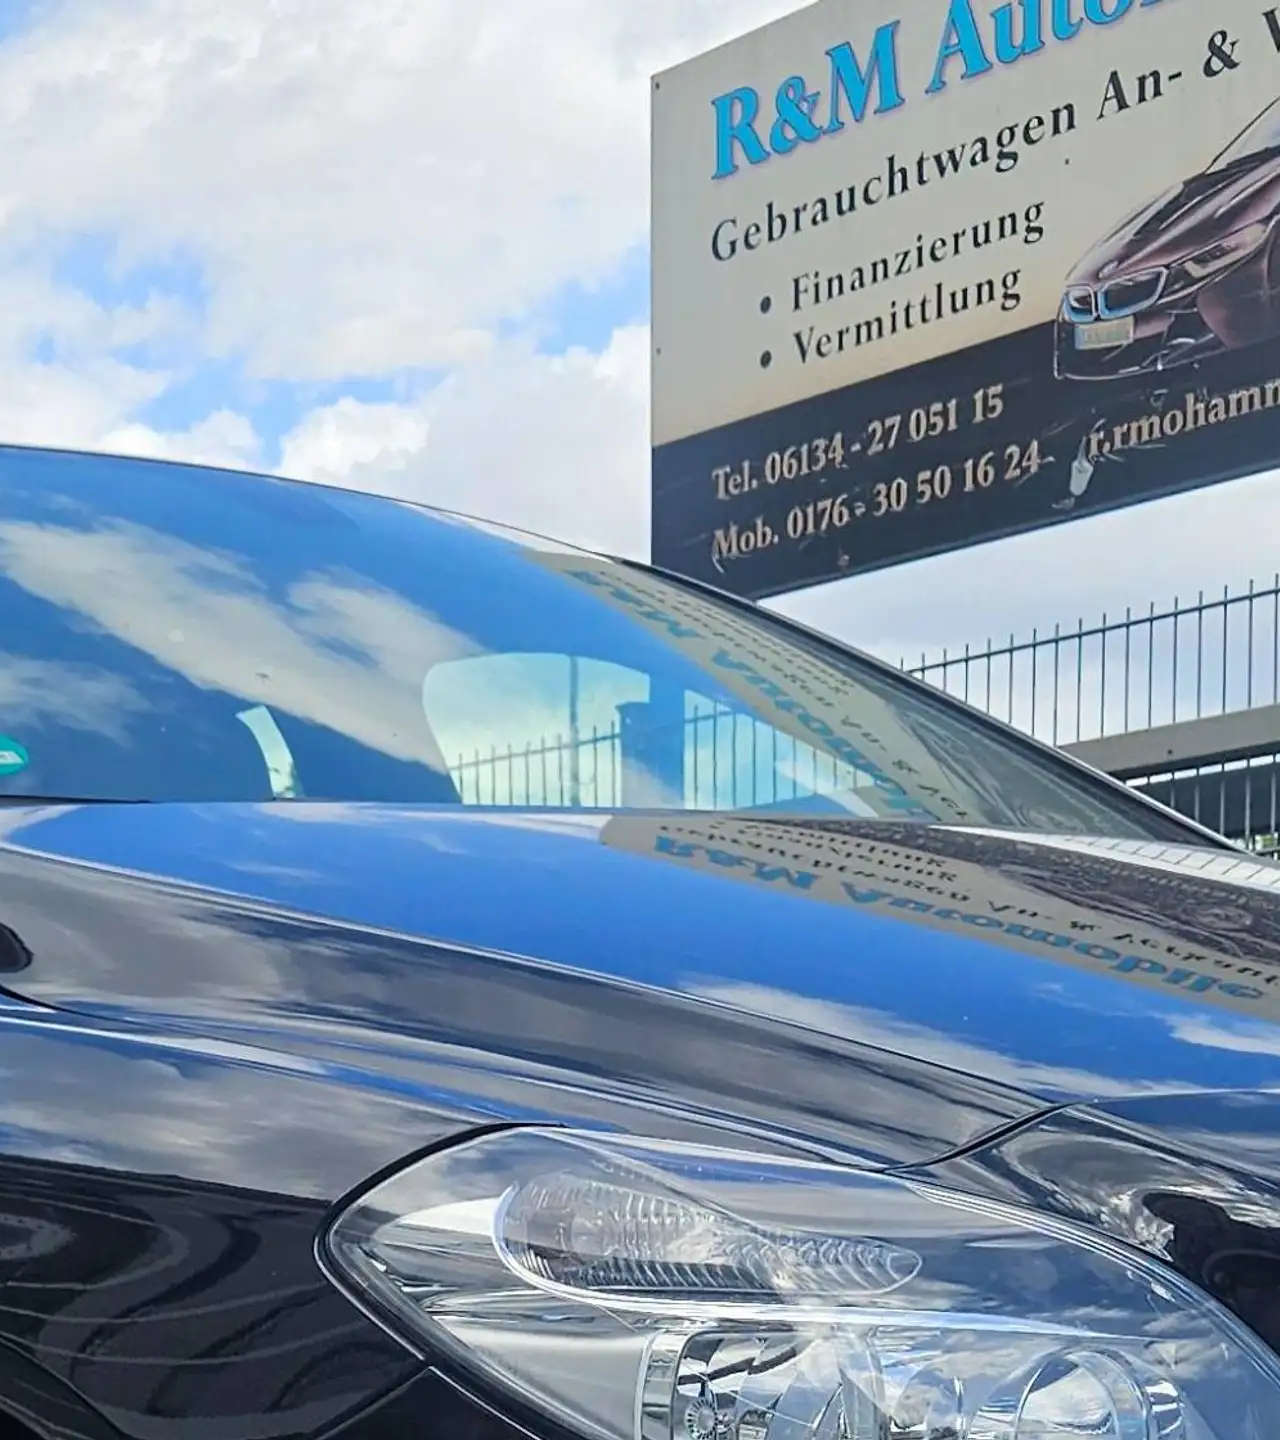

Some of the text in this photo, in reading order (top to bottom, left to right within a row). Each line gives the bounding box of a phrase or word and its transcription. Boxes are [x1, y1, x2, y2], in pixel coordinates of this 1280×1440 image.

[711, 18, 906, 181] R&M
[711, 102, 1077, 262] Gebrauchtwagen
[1096, 69, 1183, 121] An-
[1202, 29, 1241, 79] &
[792, 201, 1045, 311] Finanzierung
[793, 269, 1022, 364] Vermittlung
[711, 460, 758, 500] Tel.
[764, 432, 844, 484] 06134
[867, 415, 901, 456] 27
[908, 398, 958, 442] 051
[971, 383, 1004, 423] 15
[713, 516, 779, 560] Mob.
[786, 493, 850, 540] 0176
[872, 477, 908, 516] 30
[916, 465, 952, 504] 50
[962, 452, 995, 492] 16
[1004, 438, 1041, 480] 24
